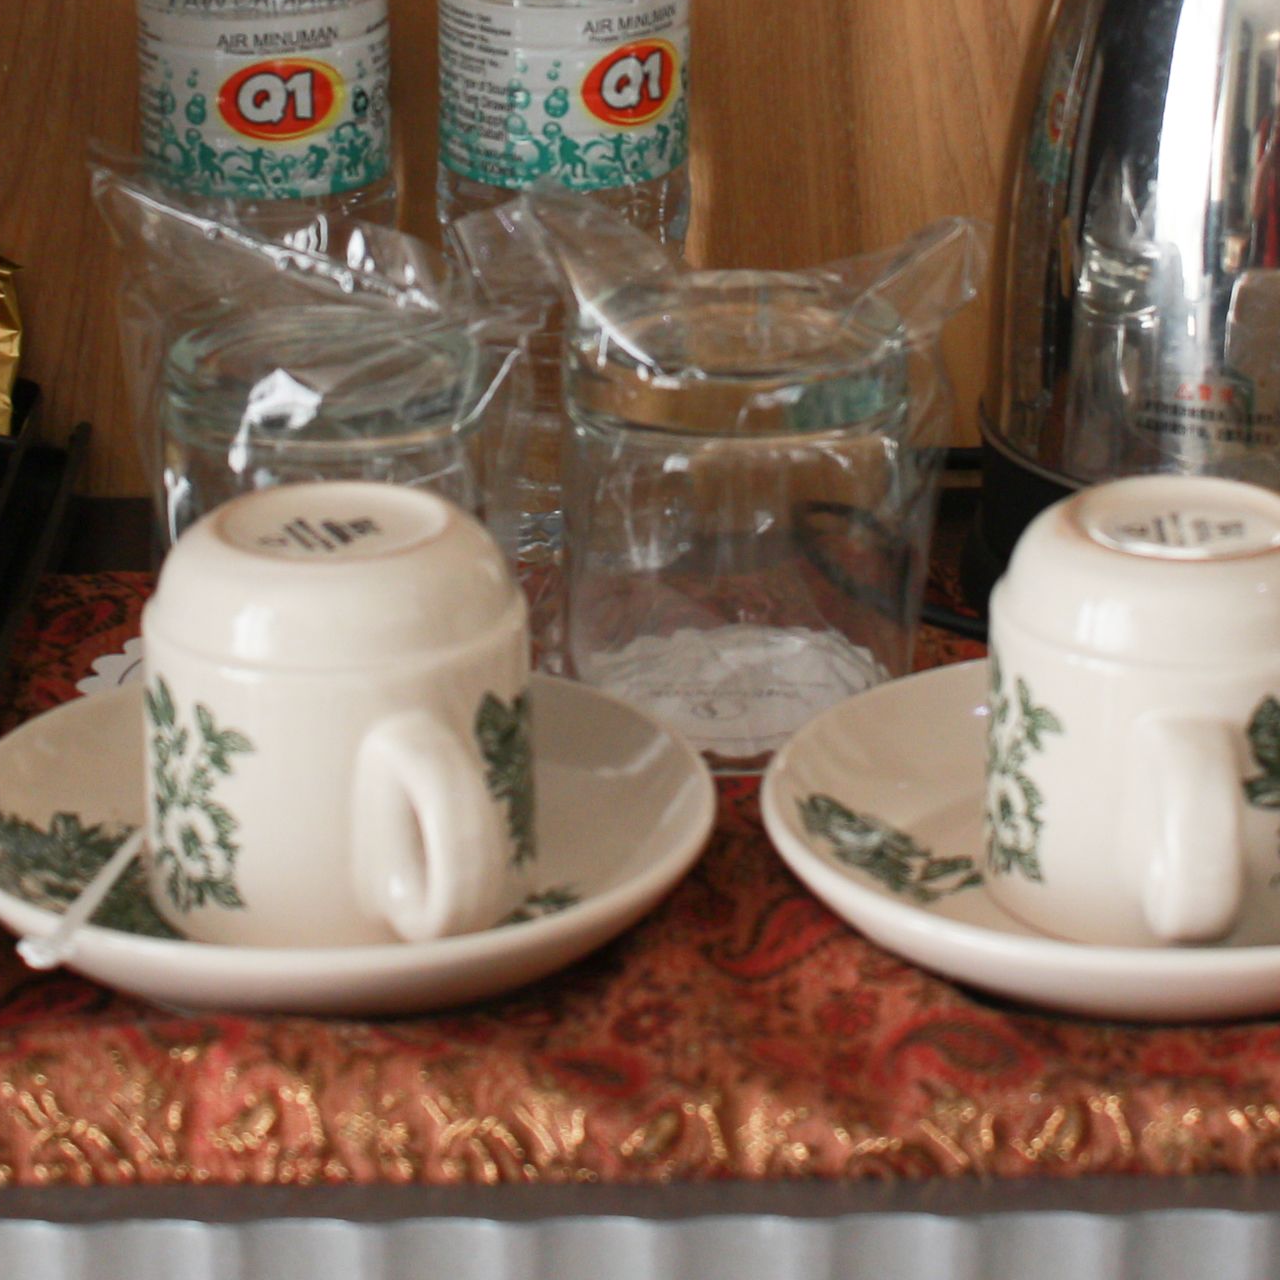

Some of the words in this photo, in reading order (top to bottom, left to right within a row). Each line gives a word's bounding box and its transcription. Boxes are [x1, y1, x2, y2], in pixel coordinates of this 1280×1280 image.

[217, 33, 248, 50] AIR
[252, 23, 340, 49] MINUMAN
[582, 19, 614, 37] AIR
[616, 3, 678, 33] MINUMAN
[236, 69, 315, 126] Q1
[599, 49, 666, 112] Q1
